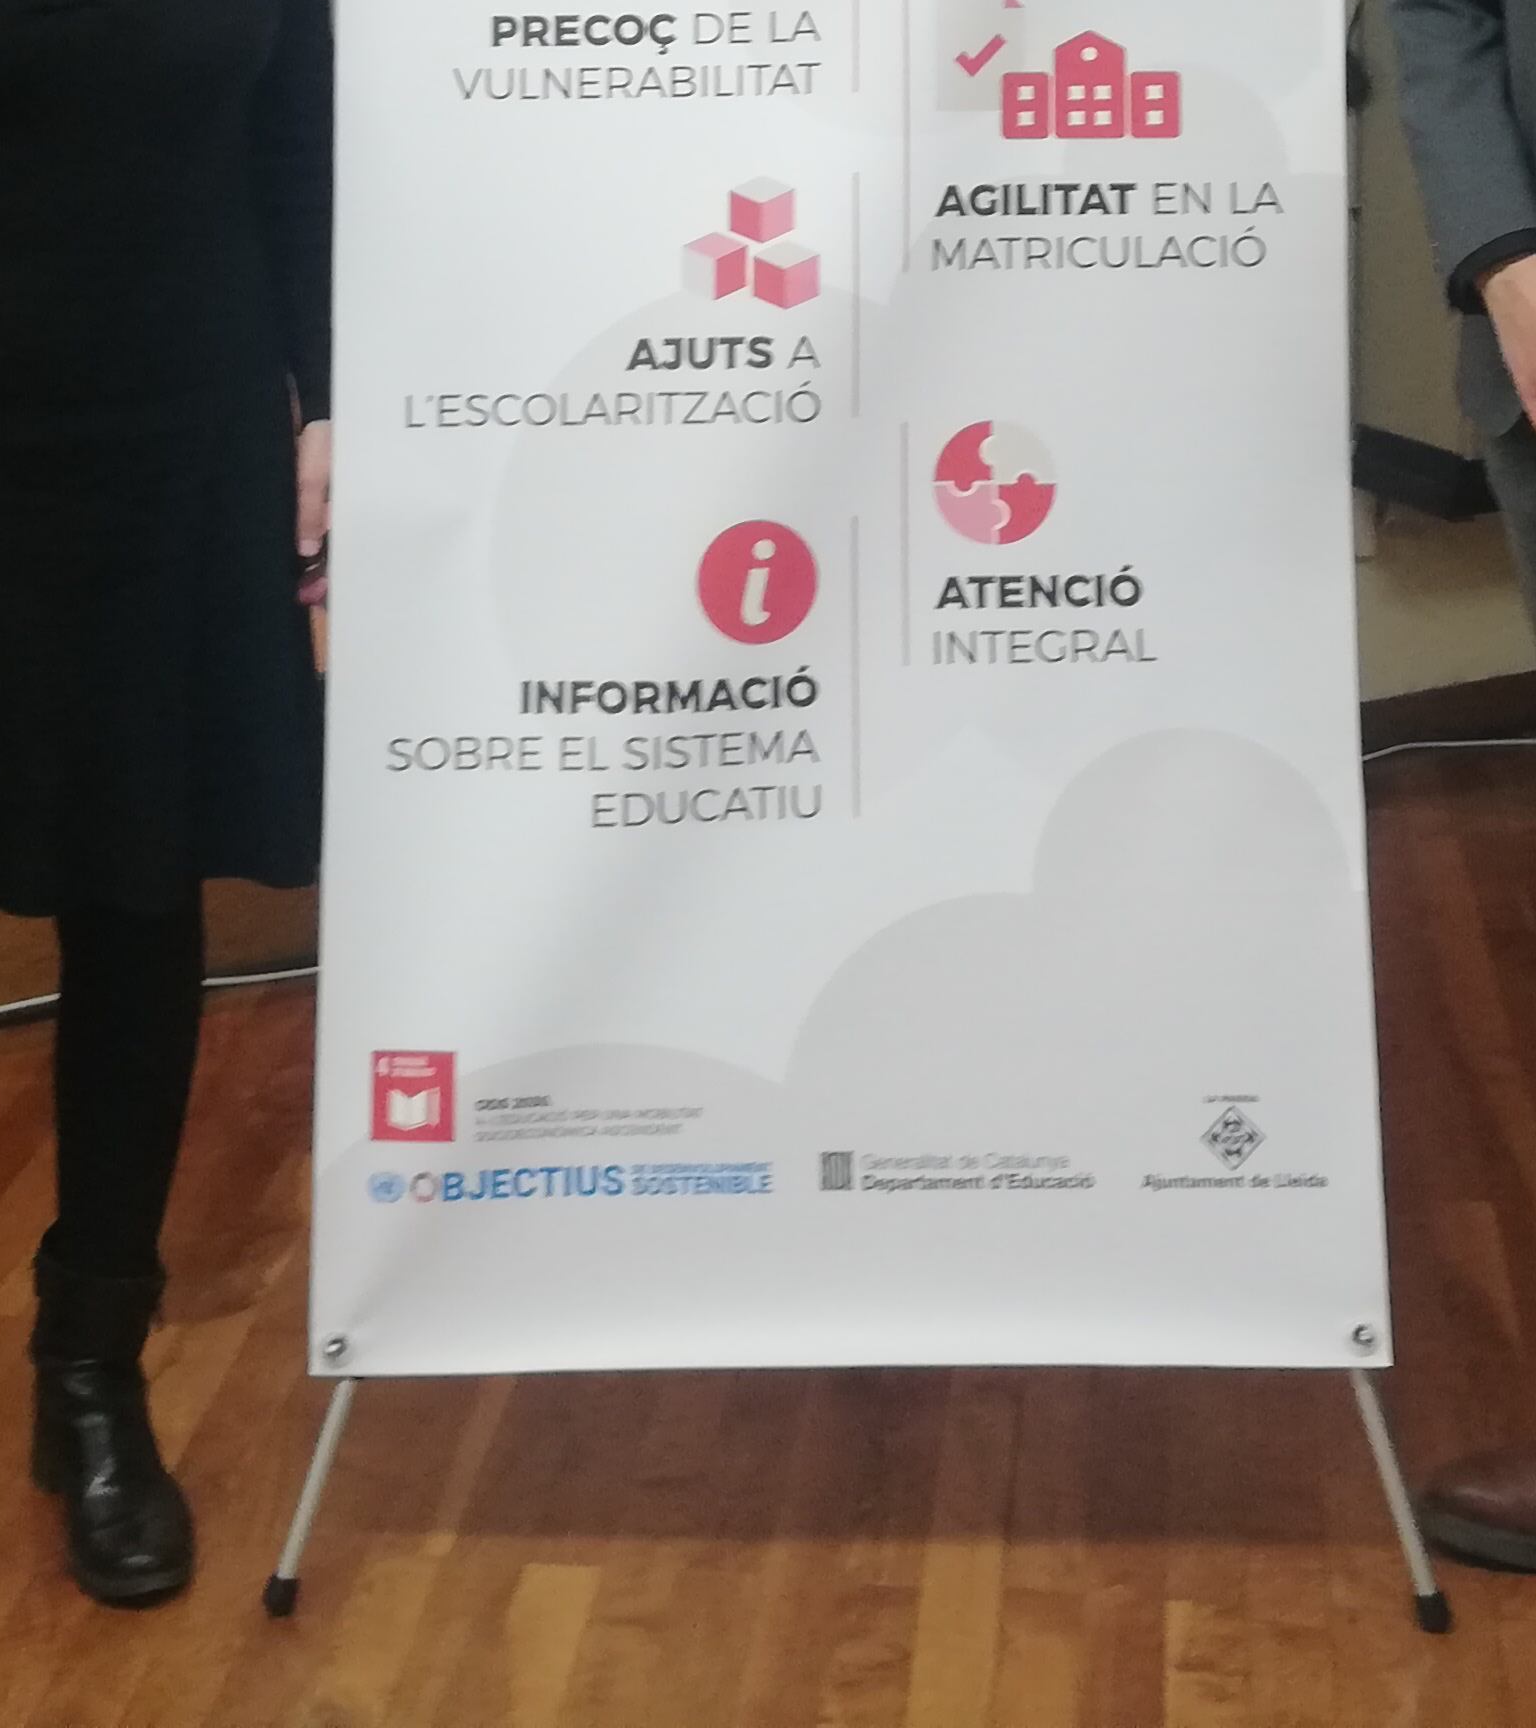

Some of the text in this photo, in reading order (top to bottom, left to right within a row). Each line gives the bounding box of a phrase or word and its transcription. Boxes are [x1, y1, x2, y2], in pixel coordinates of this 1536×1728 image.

[492, 10, 820, 55] PRECOÇ DE LA
[454, 62, 821, 100] VULNERABILITAT
[935, 182, 1283, 217] AGILITAT EN LA
[932, 226, 1266, 270] MATRICULACIÓ
[626, 336, 820, 371] AJUTS A
[406, 380, 822, 428] L'ESCOLARITZACIÓ
[936, 565, 1142, 609] ATENCIÓ
[935, 629, 1157, 664] INTEGRAL
[522, 665, 818, 714] INFORMACIÓ
[386, 730, 819, 772] SOBRE EL SISTEMA
[593, 786, 820, 828] EDUCATIU
[412, 1165, 625, 1202] OBJECTIUS
[632, 1174, 772, 1195] SOSTENIBLE
